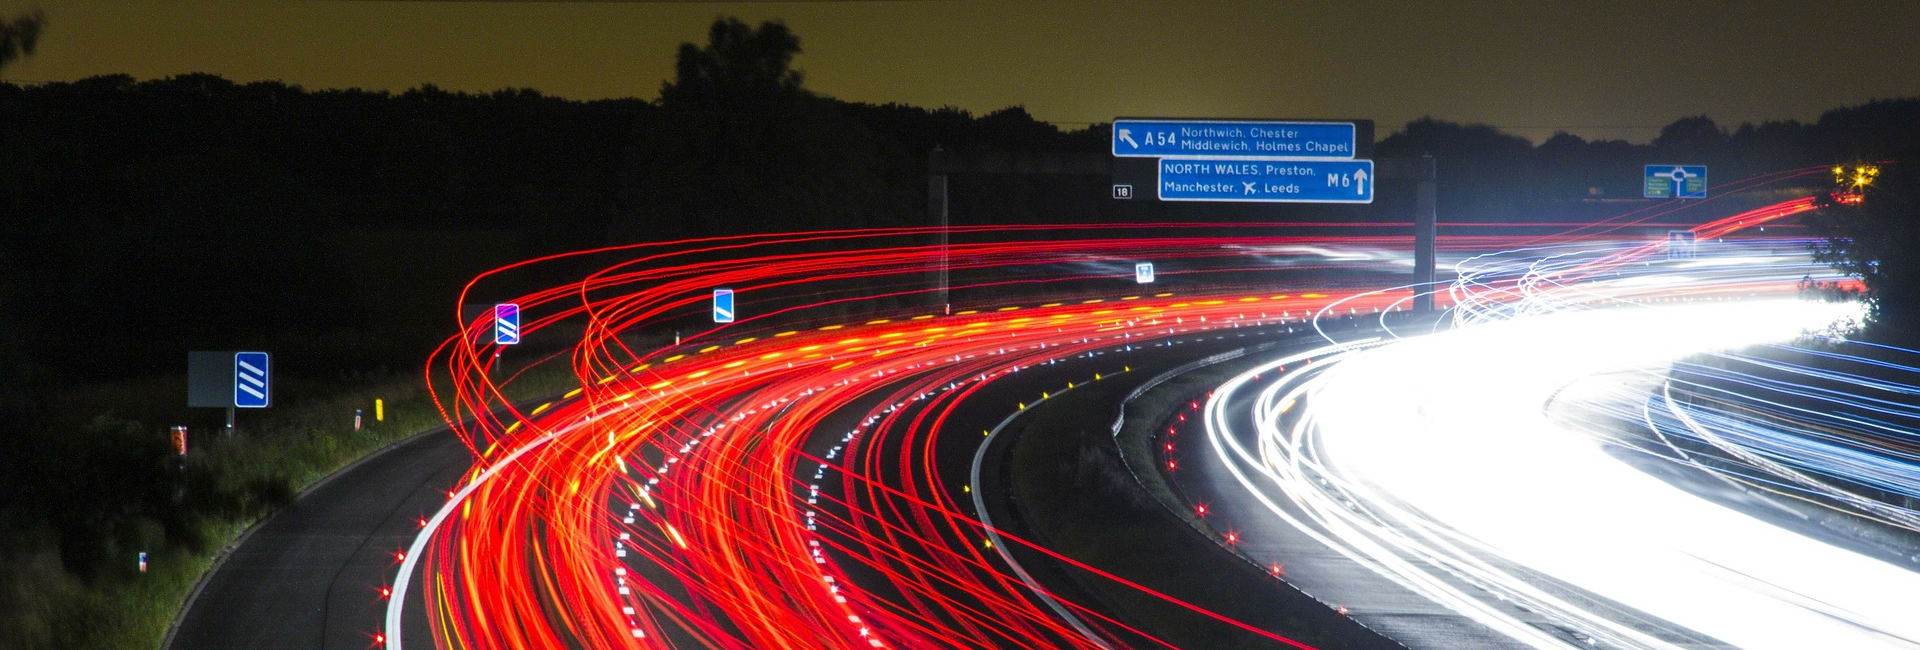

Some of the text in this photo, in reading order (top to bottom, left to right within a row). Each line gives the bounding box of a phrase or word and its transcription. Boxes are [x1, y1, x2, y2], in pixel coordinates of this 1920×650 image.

[1181, 127, 1299, 139] Northwich, Chester
[1181, 140, 1349, 153] Middlewich, Holmes Chapel
[1165, 164, 1210, 175] NORTH
[1117, 187, 1128, 197] 18
[1264, 183, 1300, 193] Leeds
